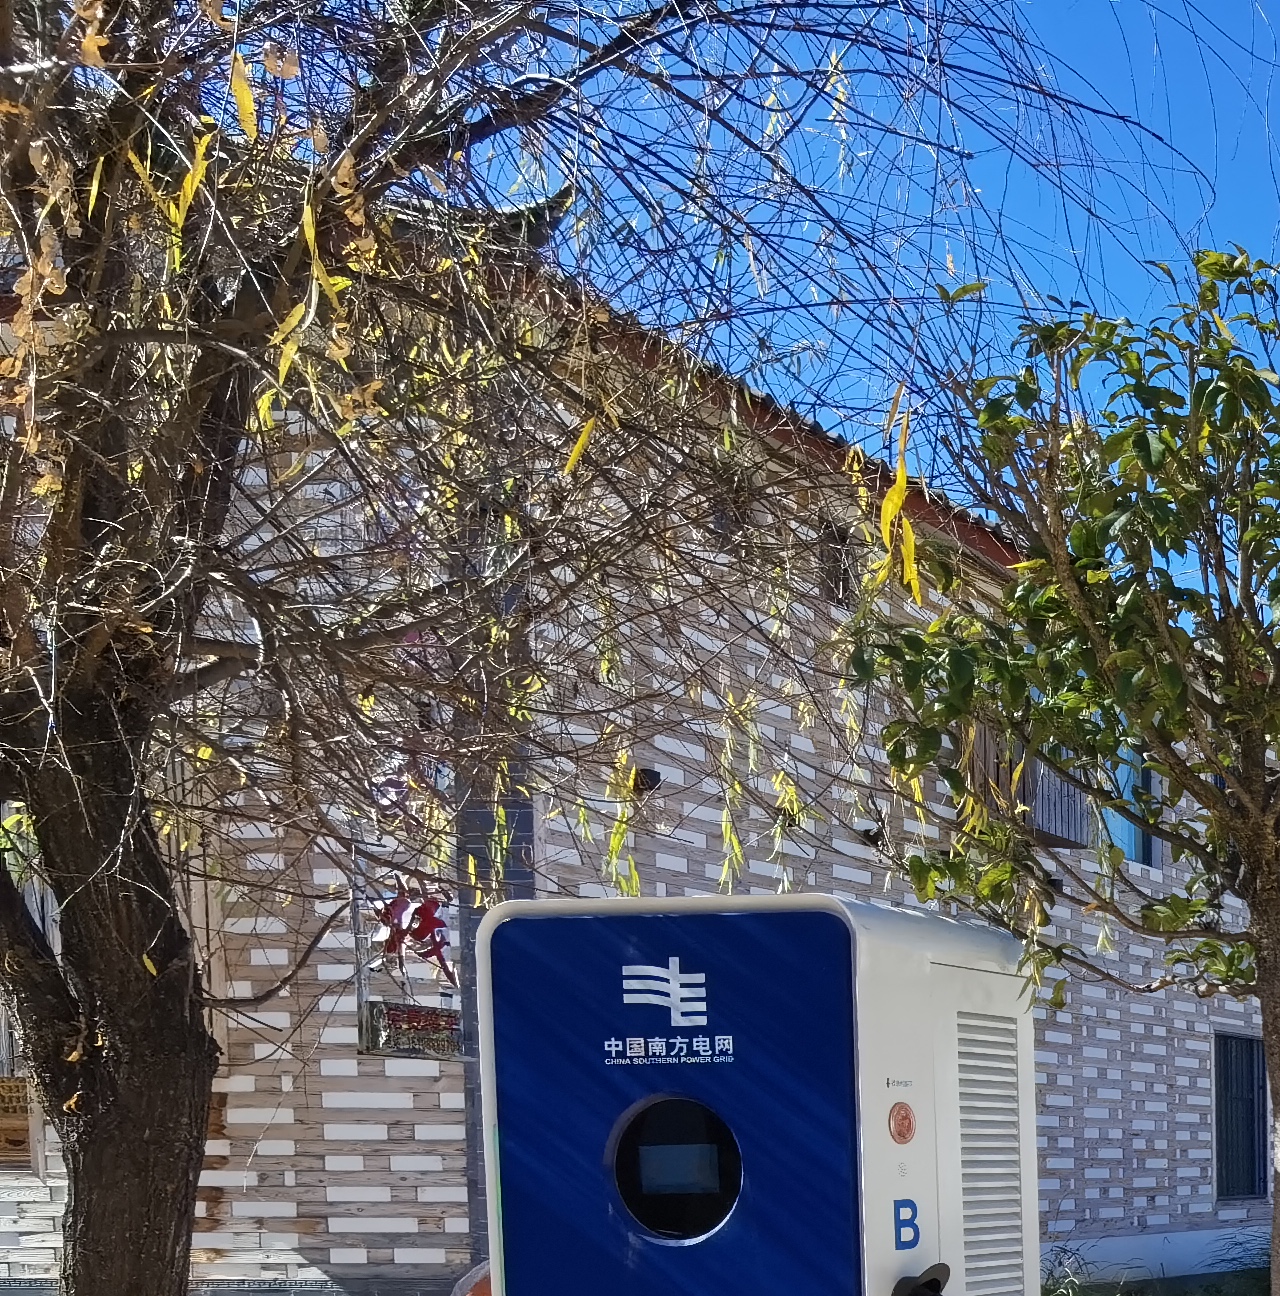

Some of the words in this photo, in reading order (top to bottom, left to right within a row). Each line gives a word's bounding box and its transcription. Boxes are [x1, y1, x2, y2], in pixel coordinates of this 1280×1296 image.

[604, 1035, 733, 1057] 中国南方电网
[604, 1058, 631, 1066] CHINA
[632, 1057, 679, 1065] SOUTHERN
[681, 1056, 711, 1064] POWER
[713, 1055, 735, 1063] GRID
[893, 1199, 920, 1251] B
